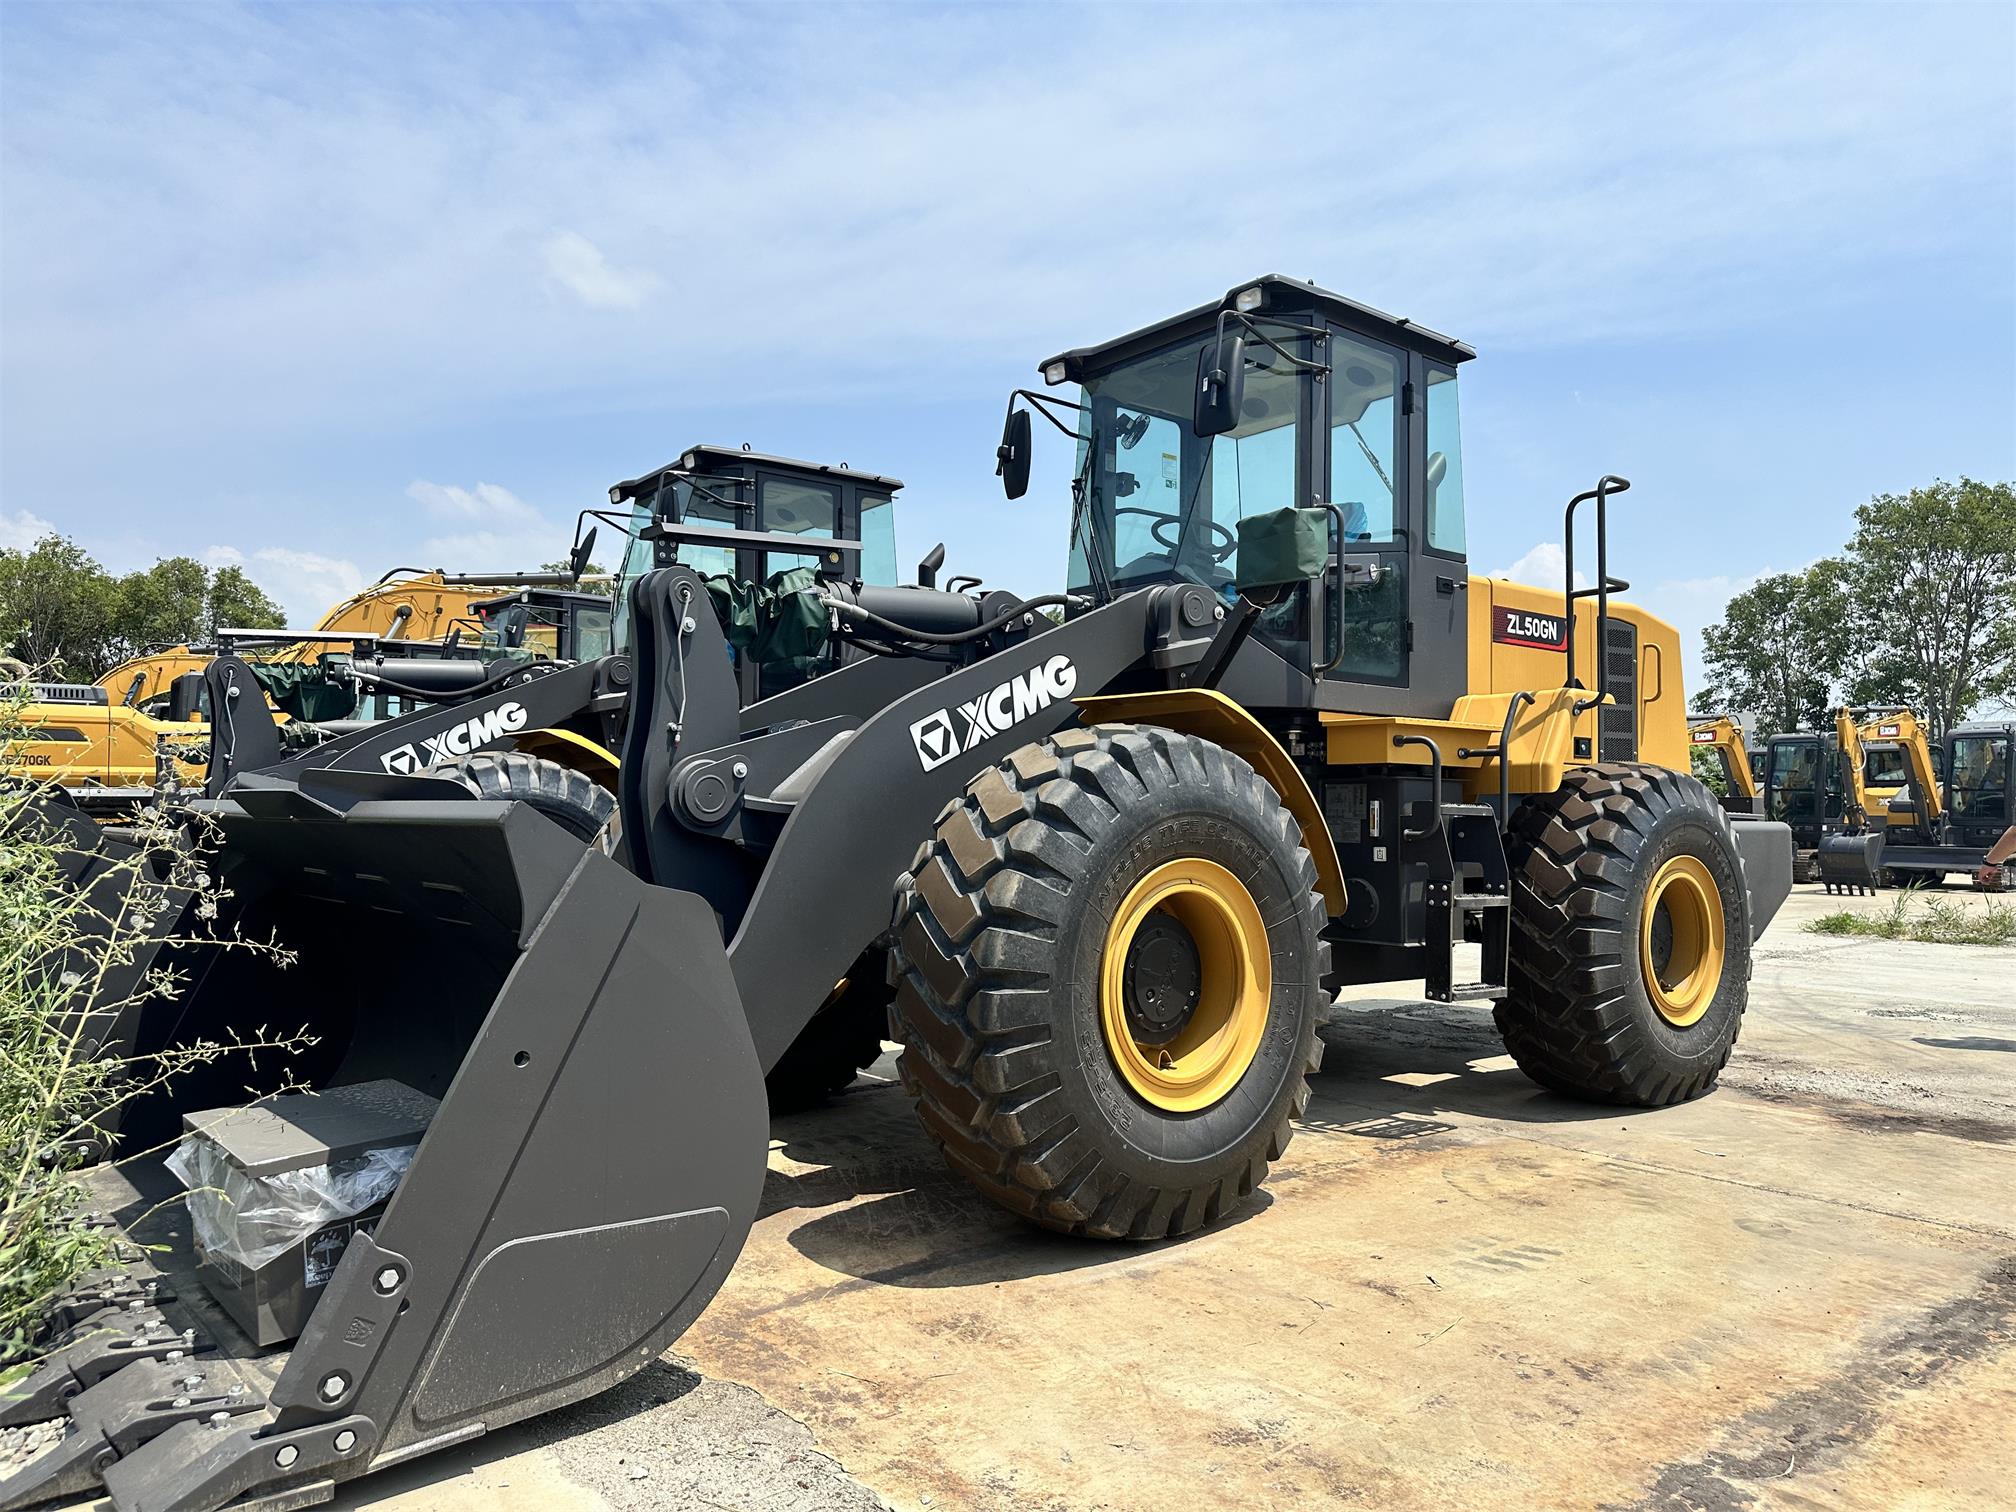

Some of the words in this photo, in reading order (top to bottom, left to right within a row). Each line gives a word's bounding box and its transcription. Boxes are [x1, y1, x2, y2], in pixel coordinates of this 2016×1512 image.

[1506, 613, 1557, 641] ZL50GN
[419, 701, 528, 766] XCMG
[955, 654, 1078, 753] XCMG
